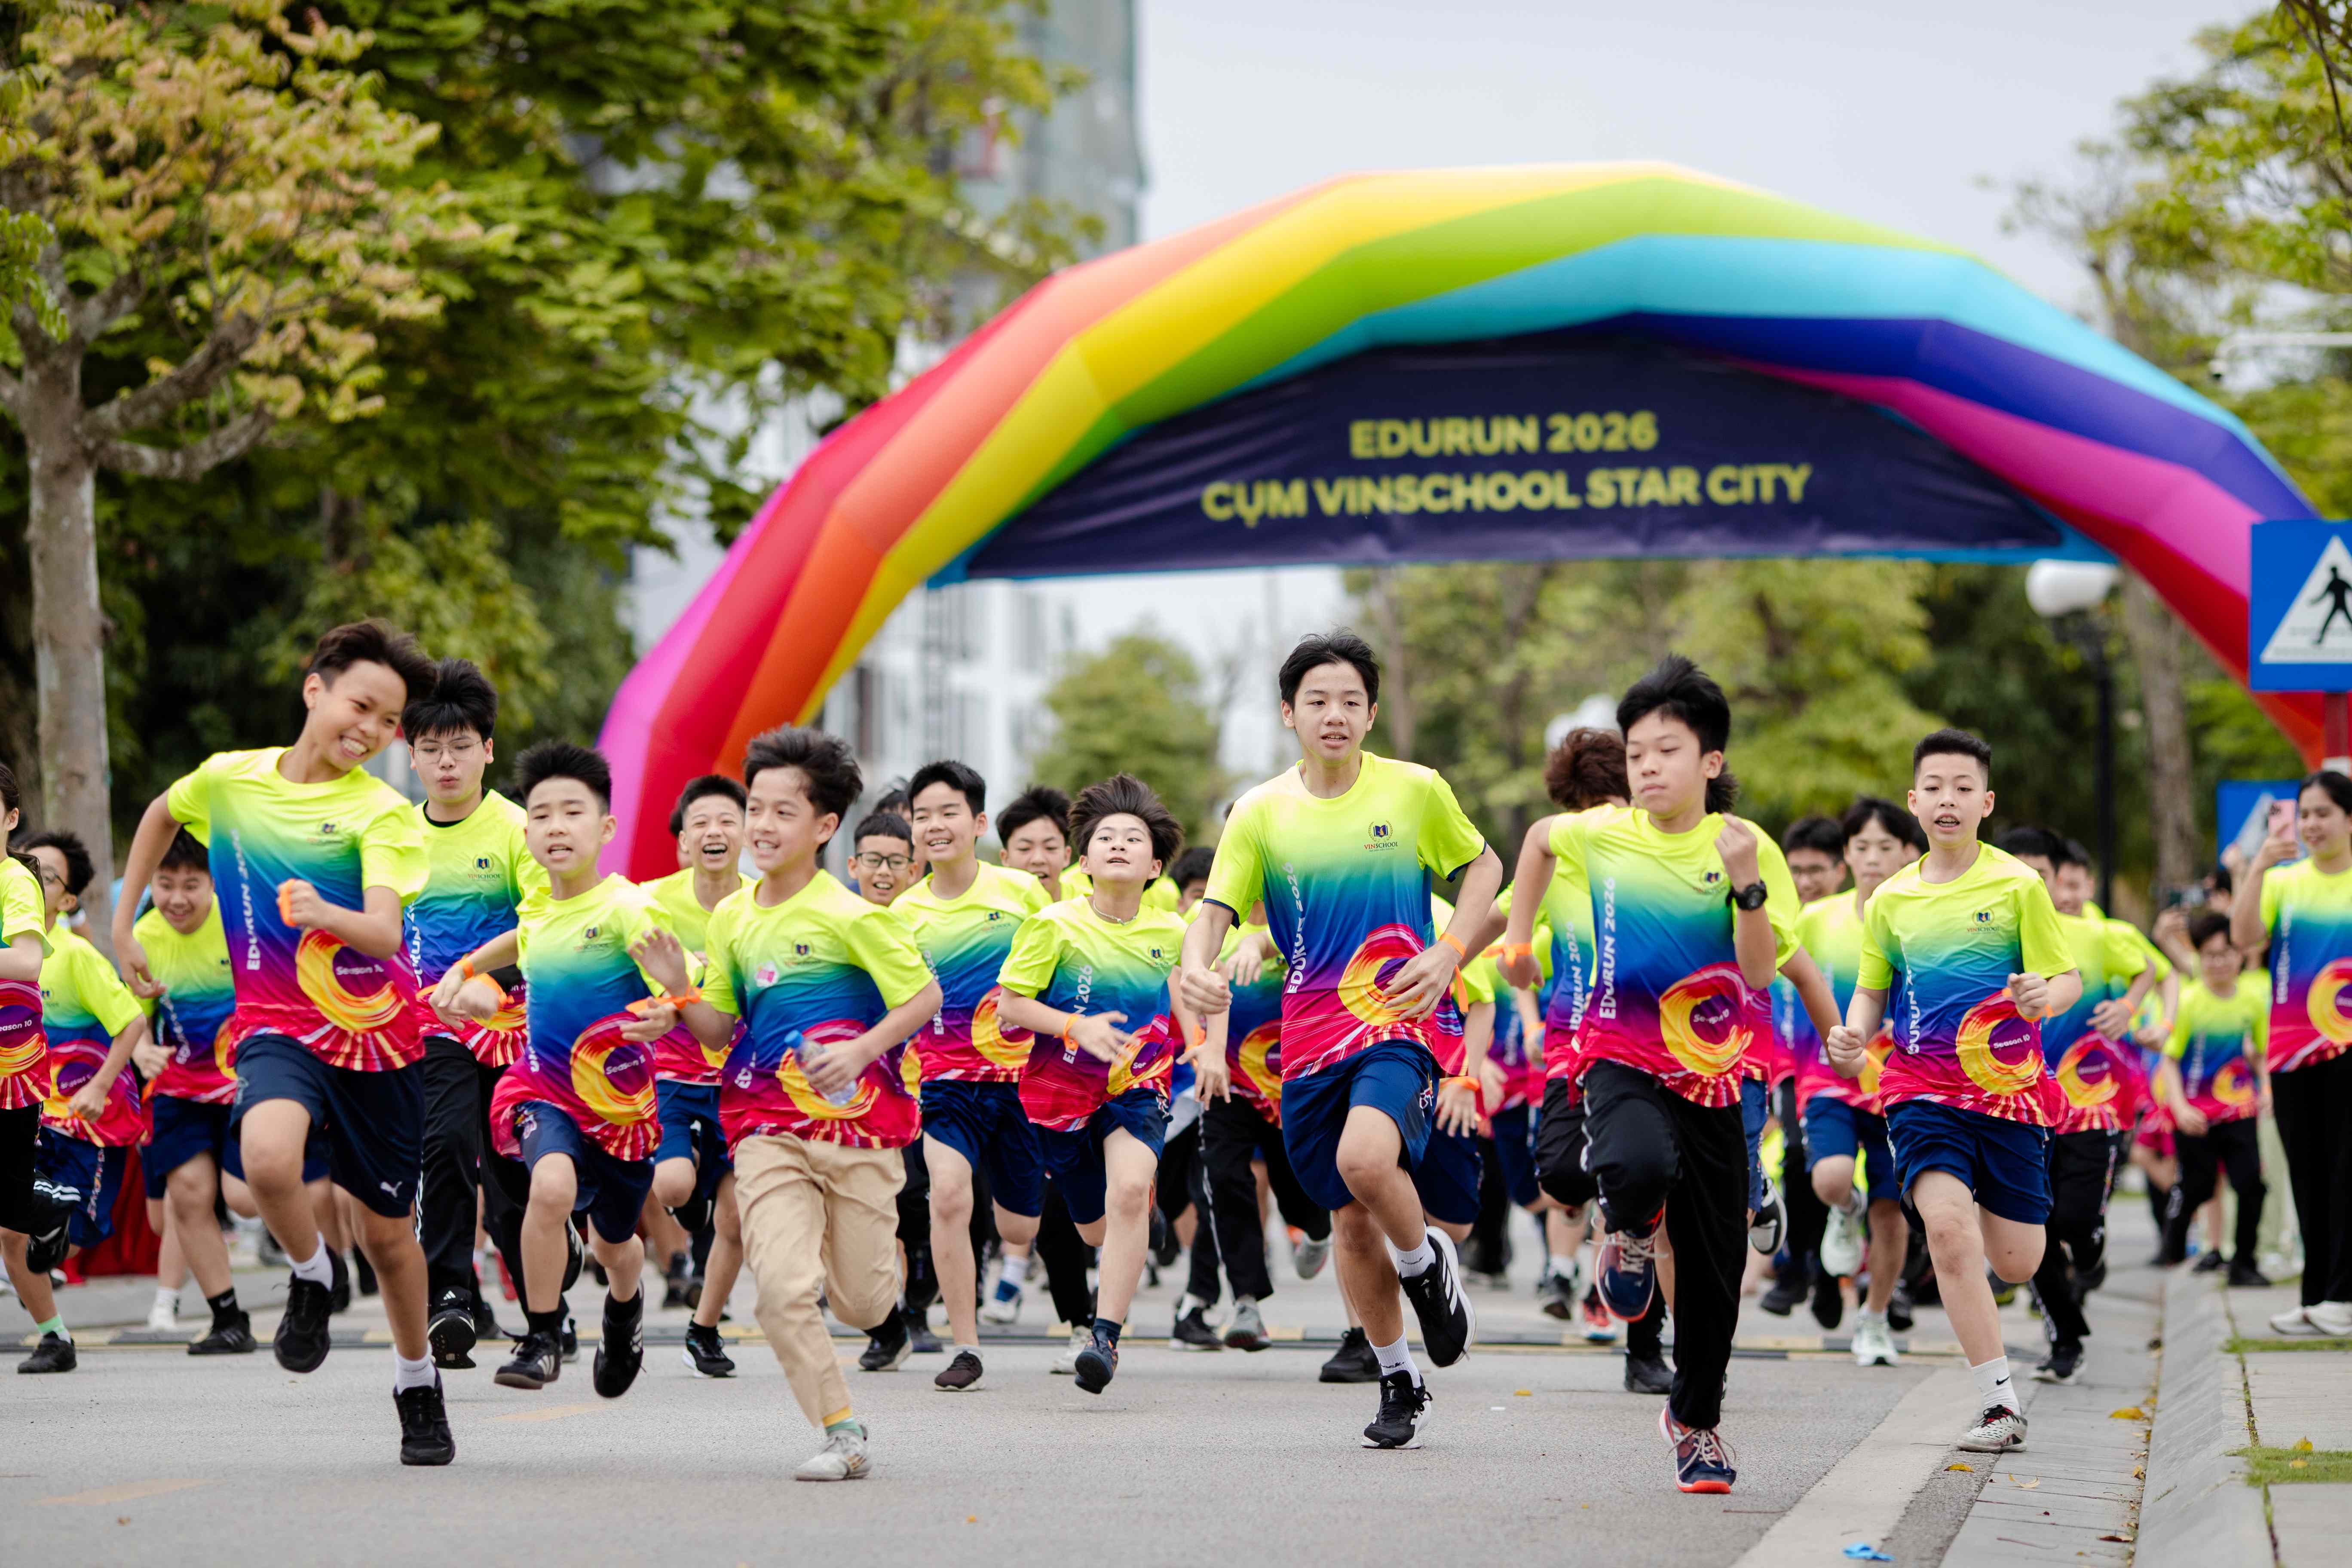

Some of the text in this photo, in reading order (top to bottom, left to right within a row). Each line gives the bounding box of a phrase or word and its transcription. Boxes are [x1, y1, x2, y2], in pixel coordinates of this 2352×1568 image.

[1350, 410, 1660, 459] EDURUN 2026
[1202, 462, 1813, 528] CỤM VINSCHOOL STAR CITY
[1363, 842, 1398, 850] VINSCHOOL
[1599, 876, 1617, 1019] EDURUN 2026
[1075, 964, 1093, 1004] 2026
[1993, 1038, 2023, 1049] Season
